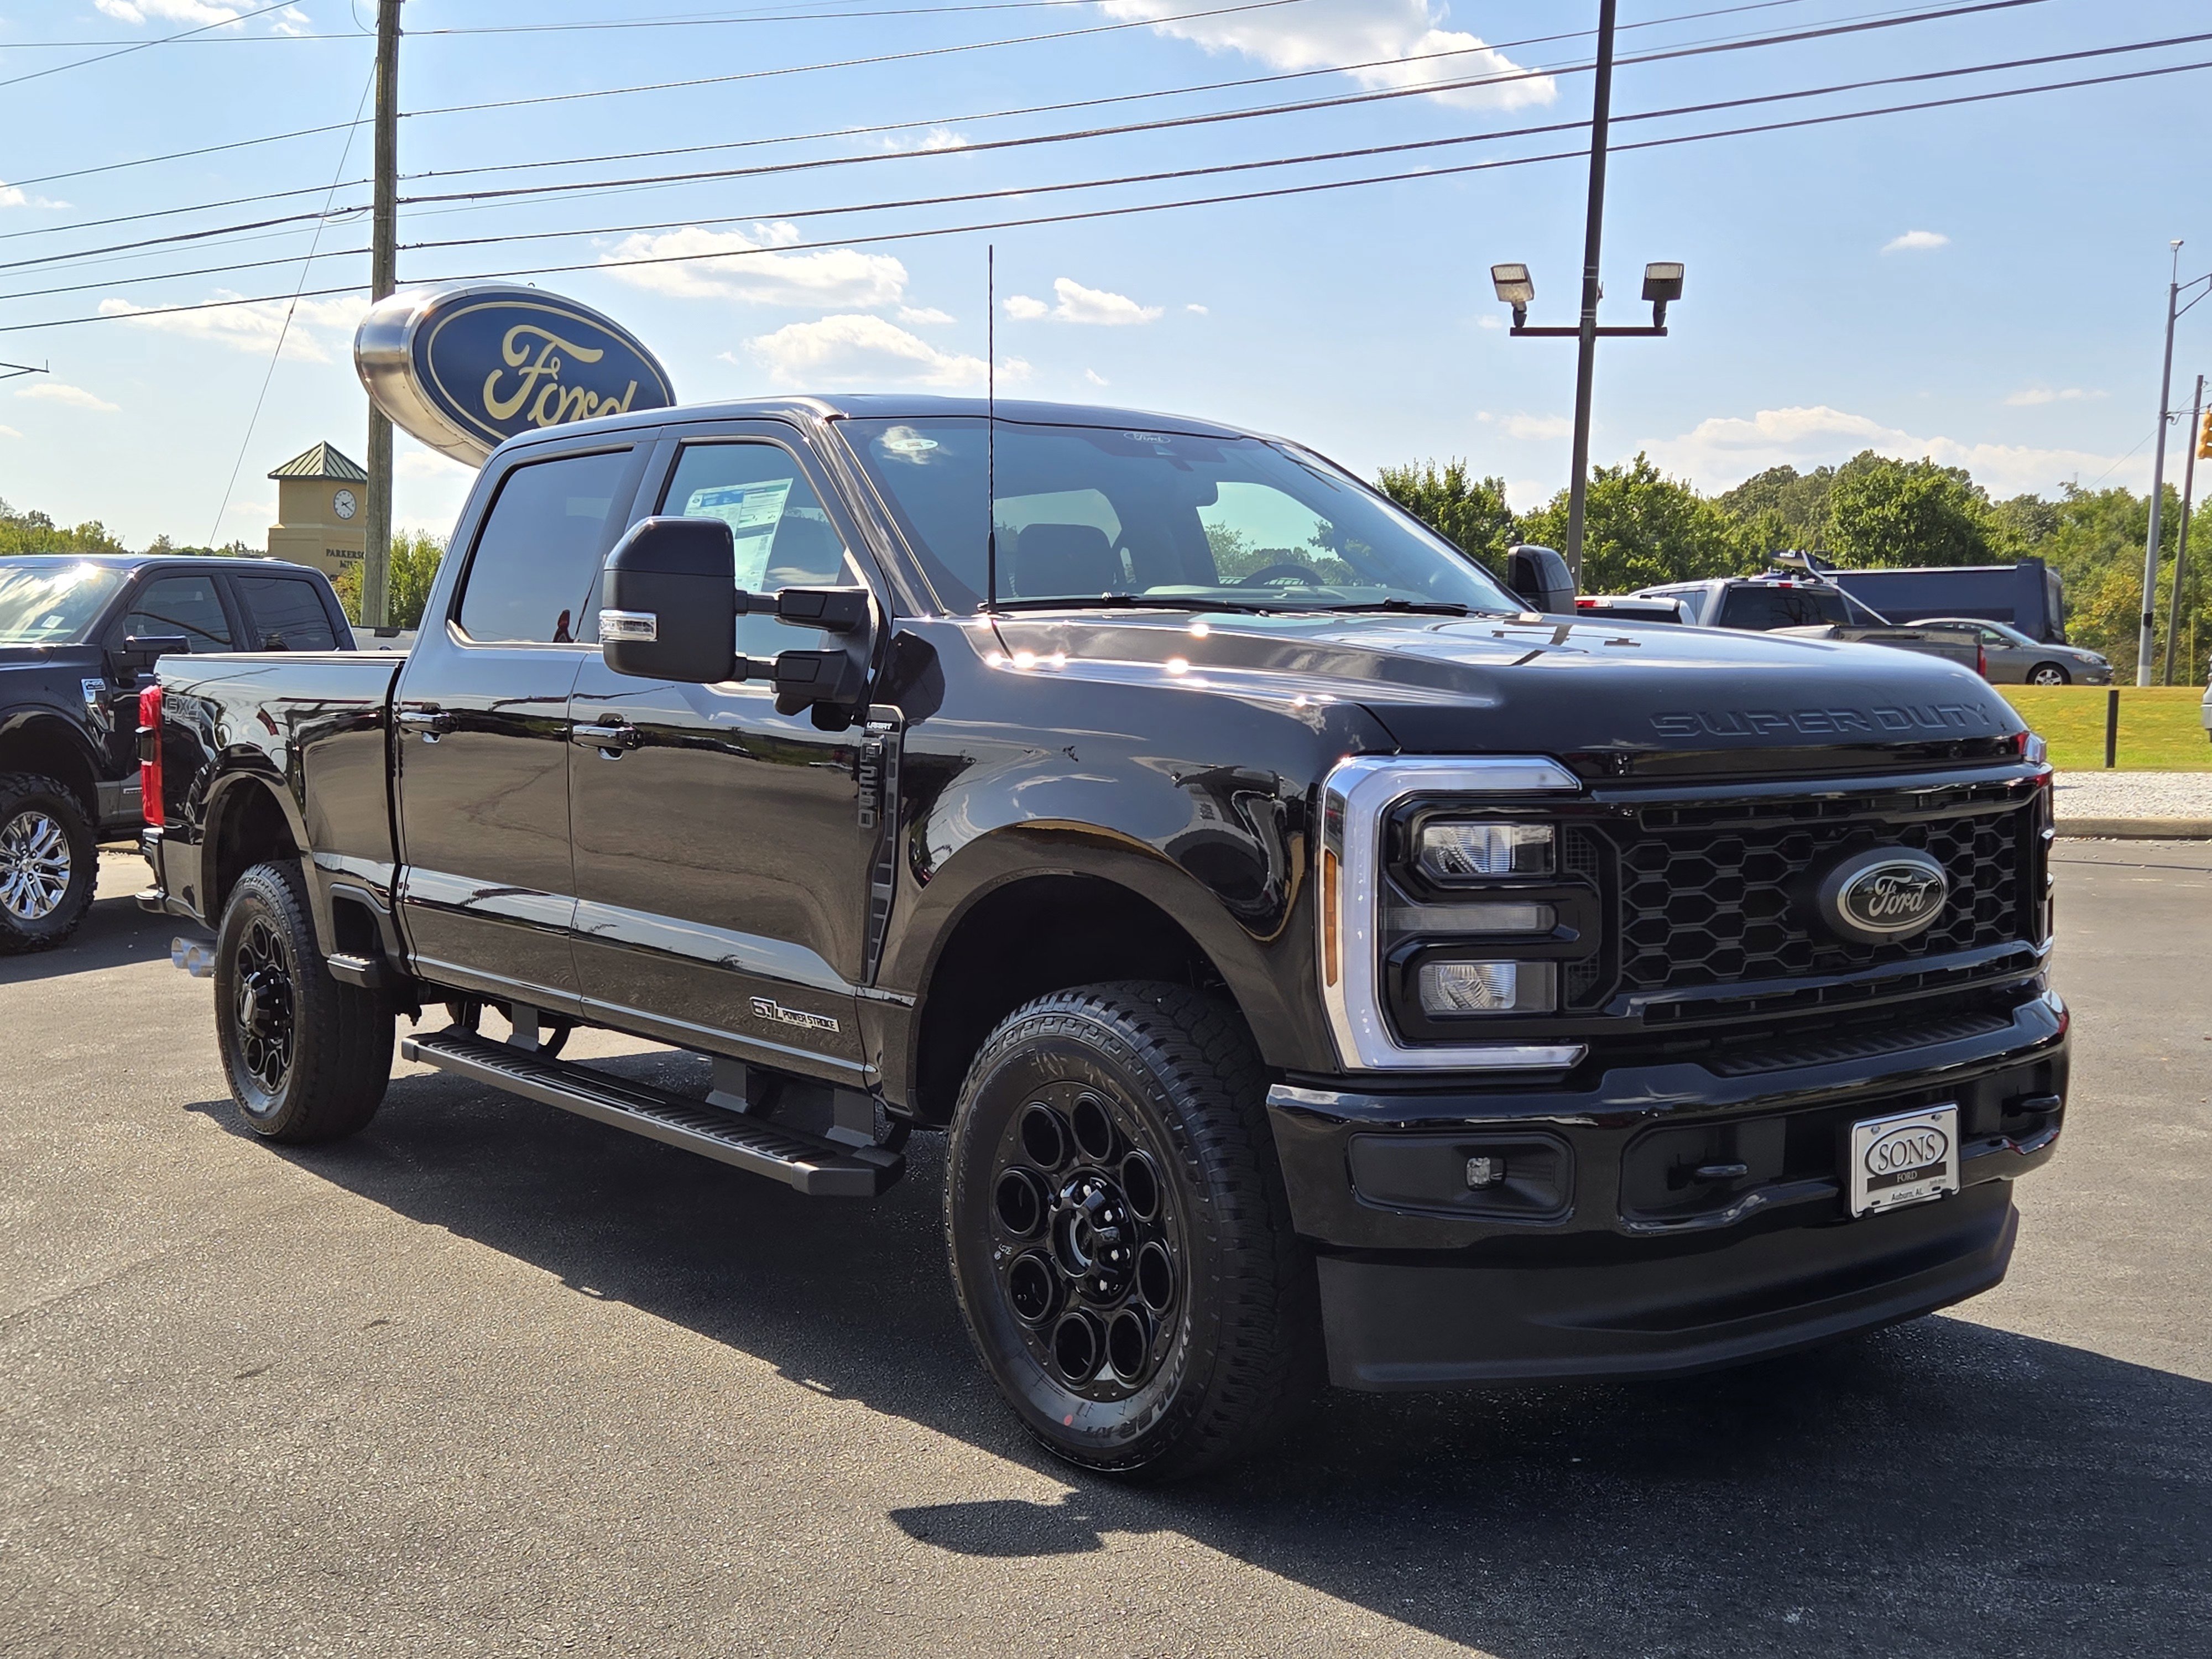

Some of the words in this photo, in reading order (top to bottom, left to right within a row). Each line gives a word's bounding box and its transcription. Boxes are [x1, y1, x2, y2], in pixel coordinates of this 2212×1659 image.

[483, 325, 637, 427] Ford
[1650, 709, 1871, 737] SUPER
[1872, 703, 1990, 731] DUTY
[1869, 872, 1928, 917] Ford
[782, 1009, 807, 1024] POWER
[807, 1015, 836, 1029] STROKE
[1877, 1134, 1935, 1171] SONS
[1897, 1171, 1917, 1183] FORD
[1916, 1188, 1924, 1197] AL
